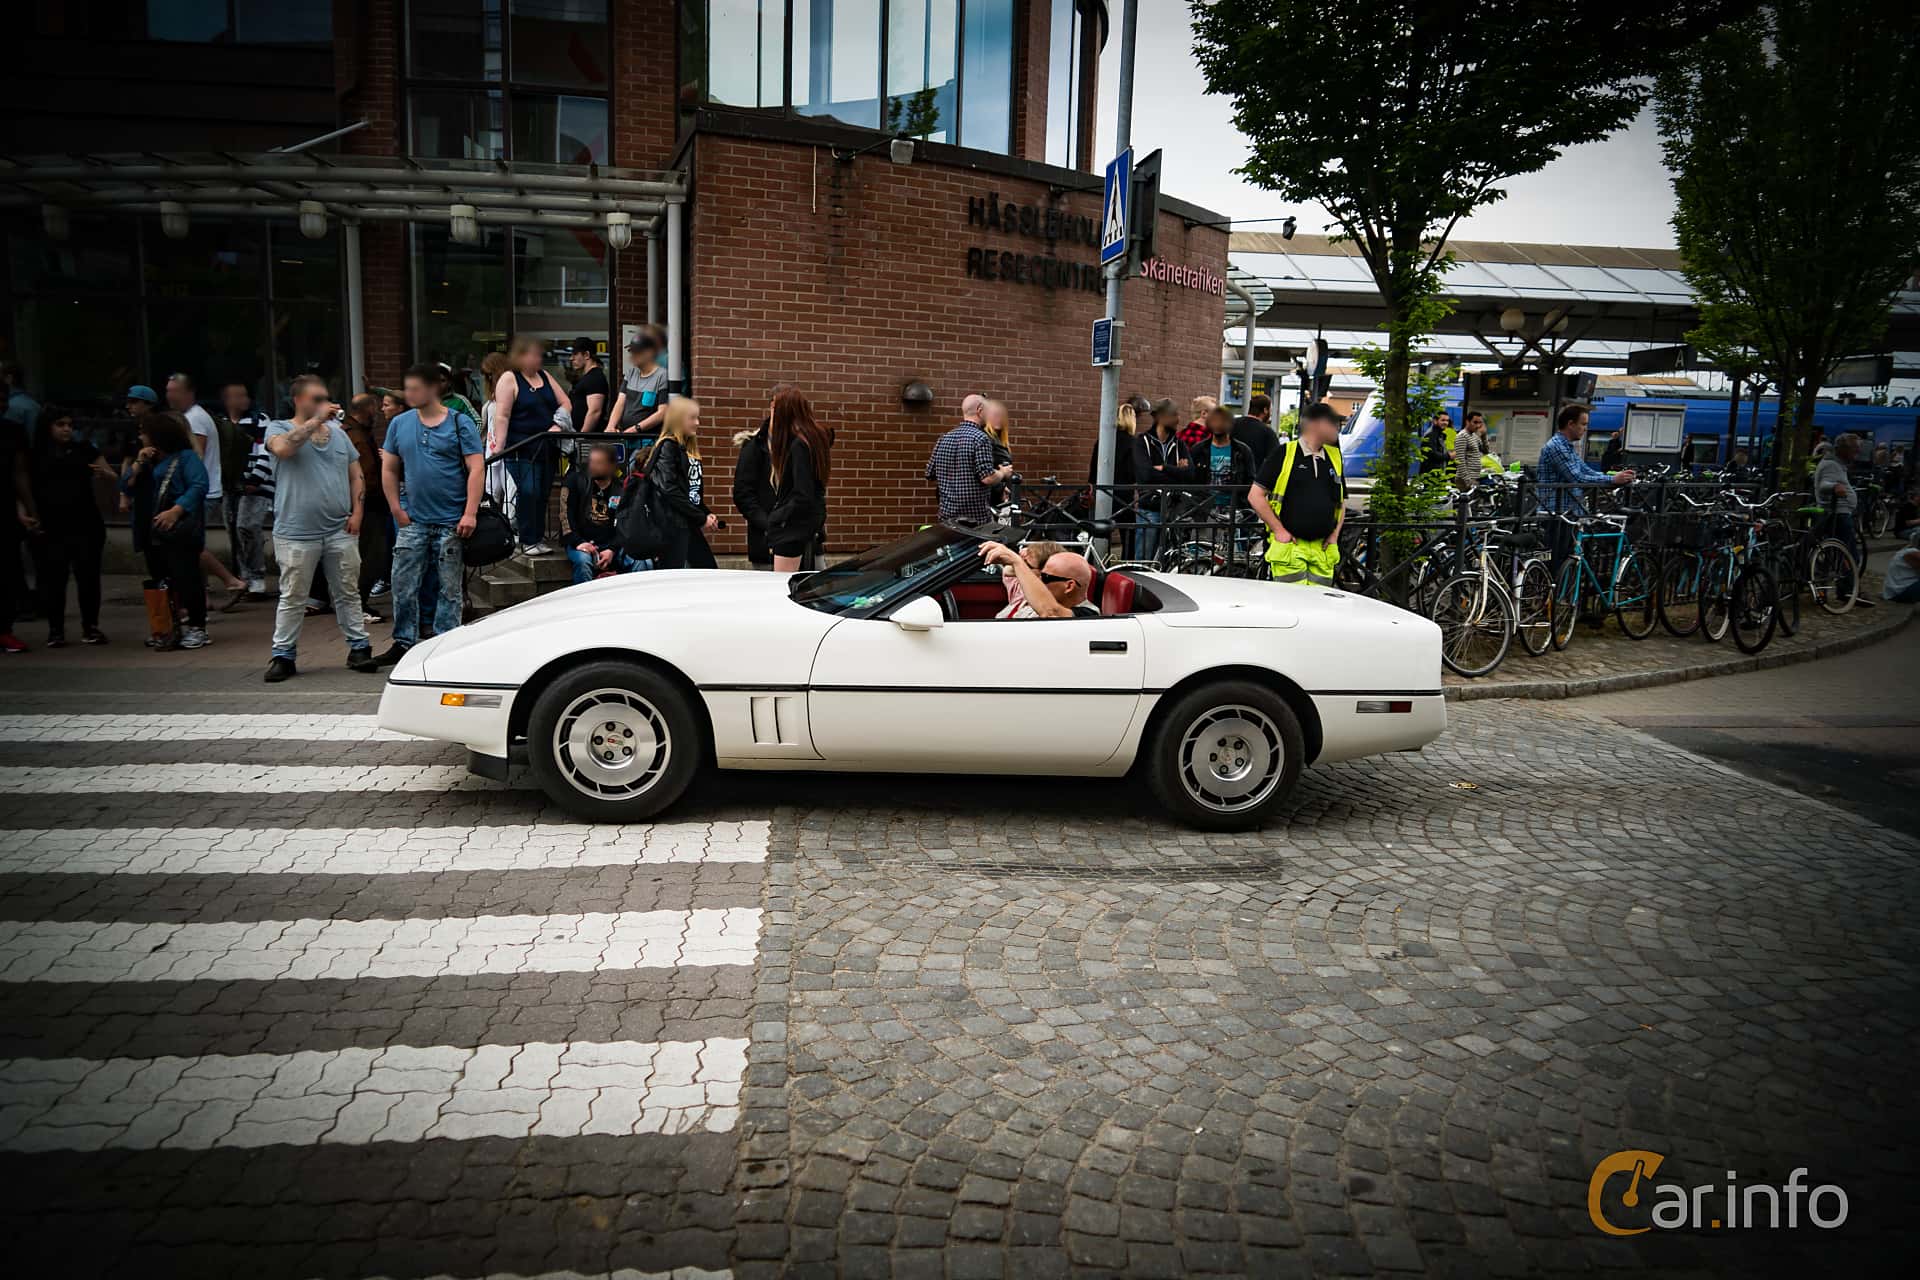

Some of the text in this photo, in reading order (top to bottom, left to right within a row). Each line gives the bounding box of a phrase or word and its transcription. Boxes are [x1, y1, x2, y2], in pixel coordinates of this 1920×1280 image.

[968, 191, 1102, 250] HÄSSLEHOL
[1140, 255, 1224, 297] Skånetrafiken
[1674, 348, 1685, 368] A
